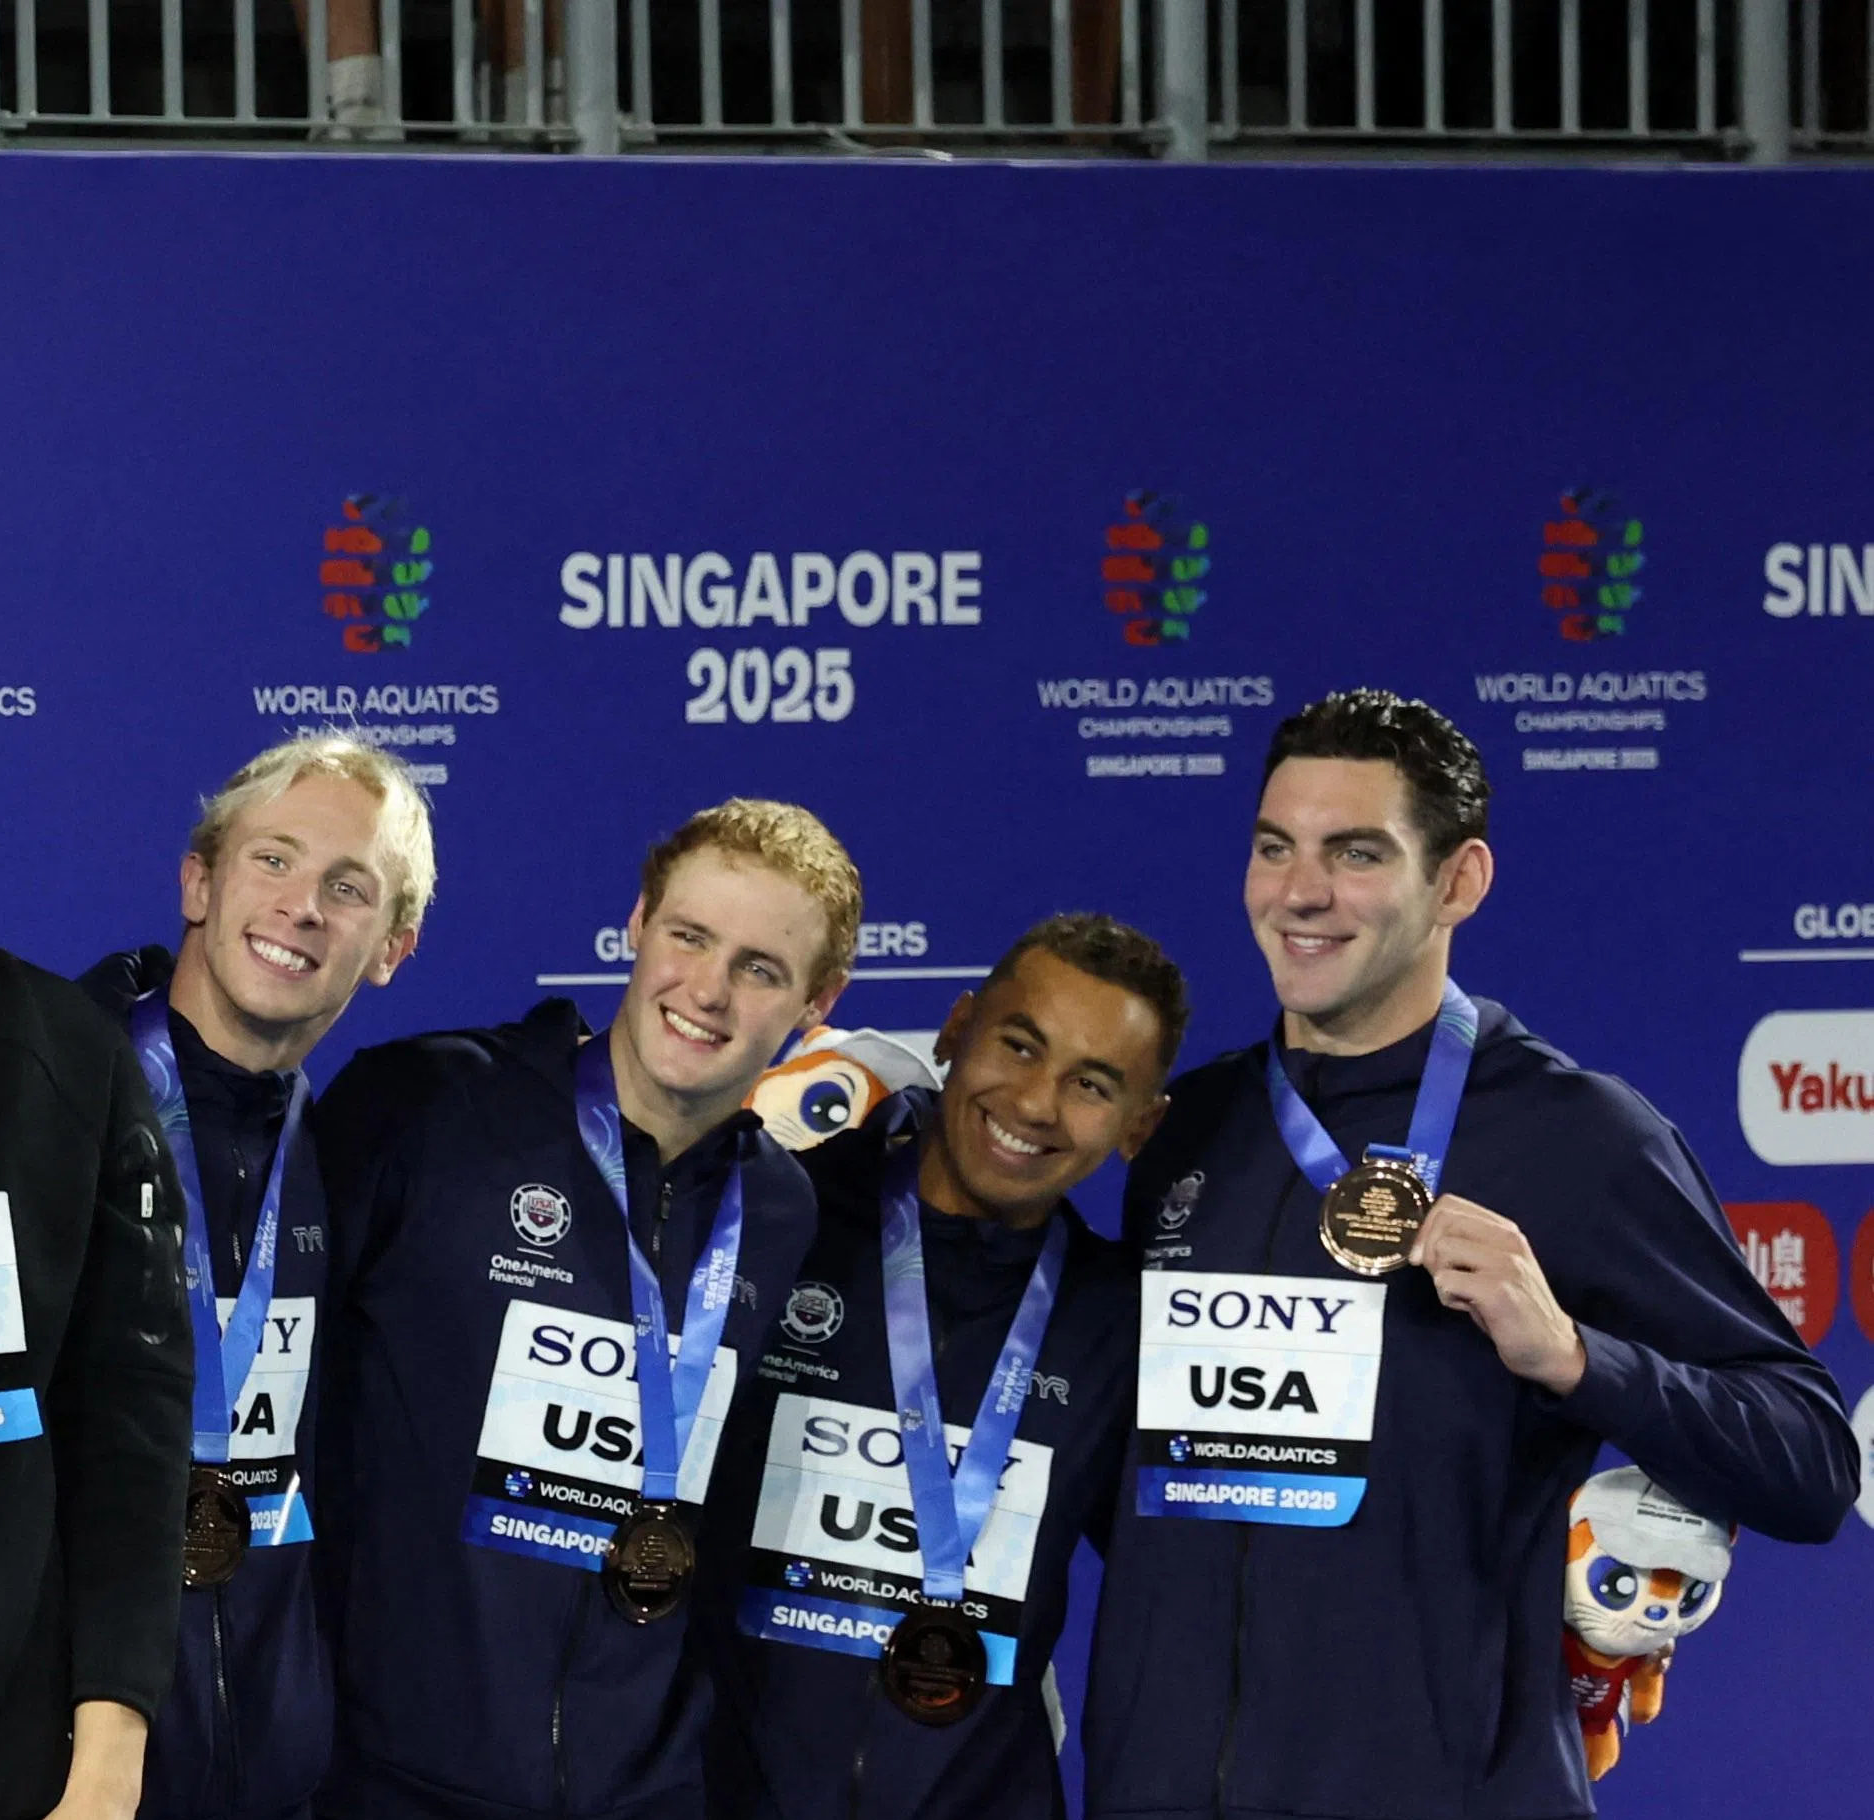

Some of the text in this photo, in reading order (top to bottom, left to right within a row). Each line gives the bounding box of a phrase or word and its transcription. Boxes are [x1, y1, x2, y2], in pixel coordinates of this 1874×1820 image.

[559, 550, 982, 628] SINGAPORE
[253, 684, 500, 715] WORLD AQUATICS
[685, 647, 855, 723] 2025
[1037, 676, 1275, 708] WORLD AQUATICS
[1474, 670, 1707, 703] WORLD AQUATICS
[1769, 1062, 1874, 1114] Yaku
[490, 1253, 574, 1284] OneAmerica
[1168, 1288, 1353, 1334] SONY
[528, 1325, 641, 1383] SO
[1189, 1365, 1319, 1415] USA
[543, 1403, 644, 1467] US
[1193, 1441, 1337, 1466] WORLD AQUATICS
[231, 1468, 278, 1485] QUATICS
[539, 1481, 602, 1507] WORLD
[1164, 1481, 1338, 1512] SINGAPORE 2025
[820, 1571, 896, 1599] WORLD
[771, 1604, 894, 1645] SINGAPO
